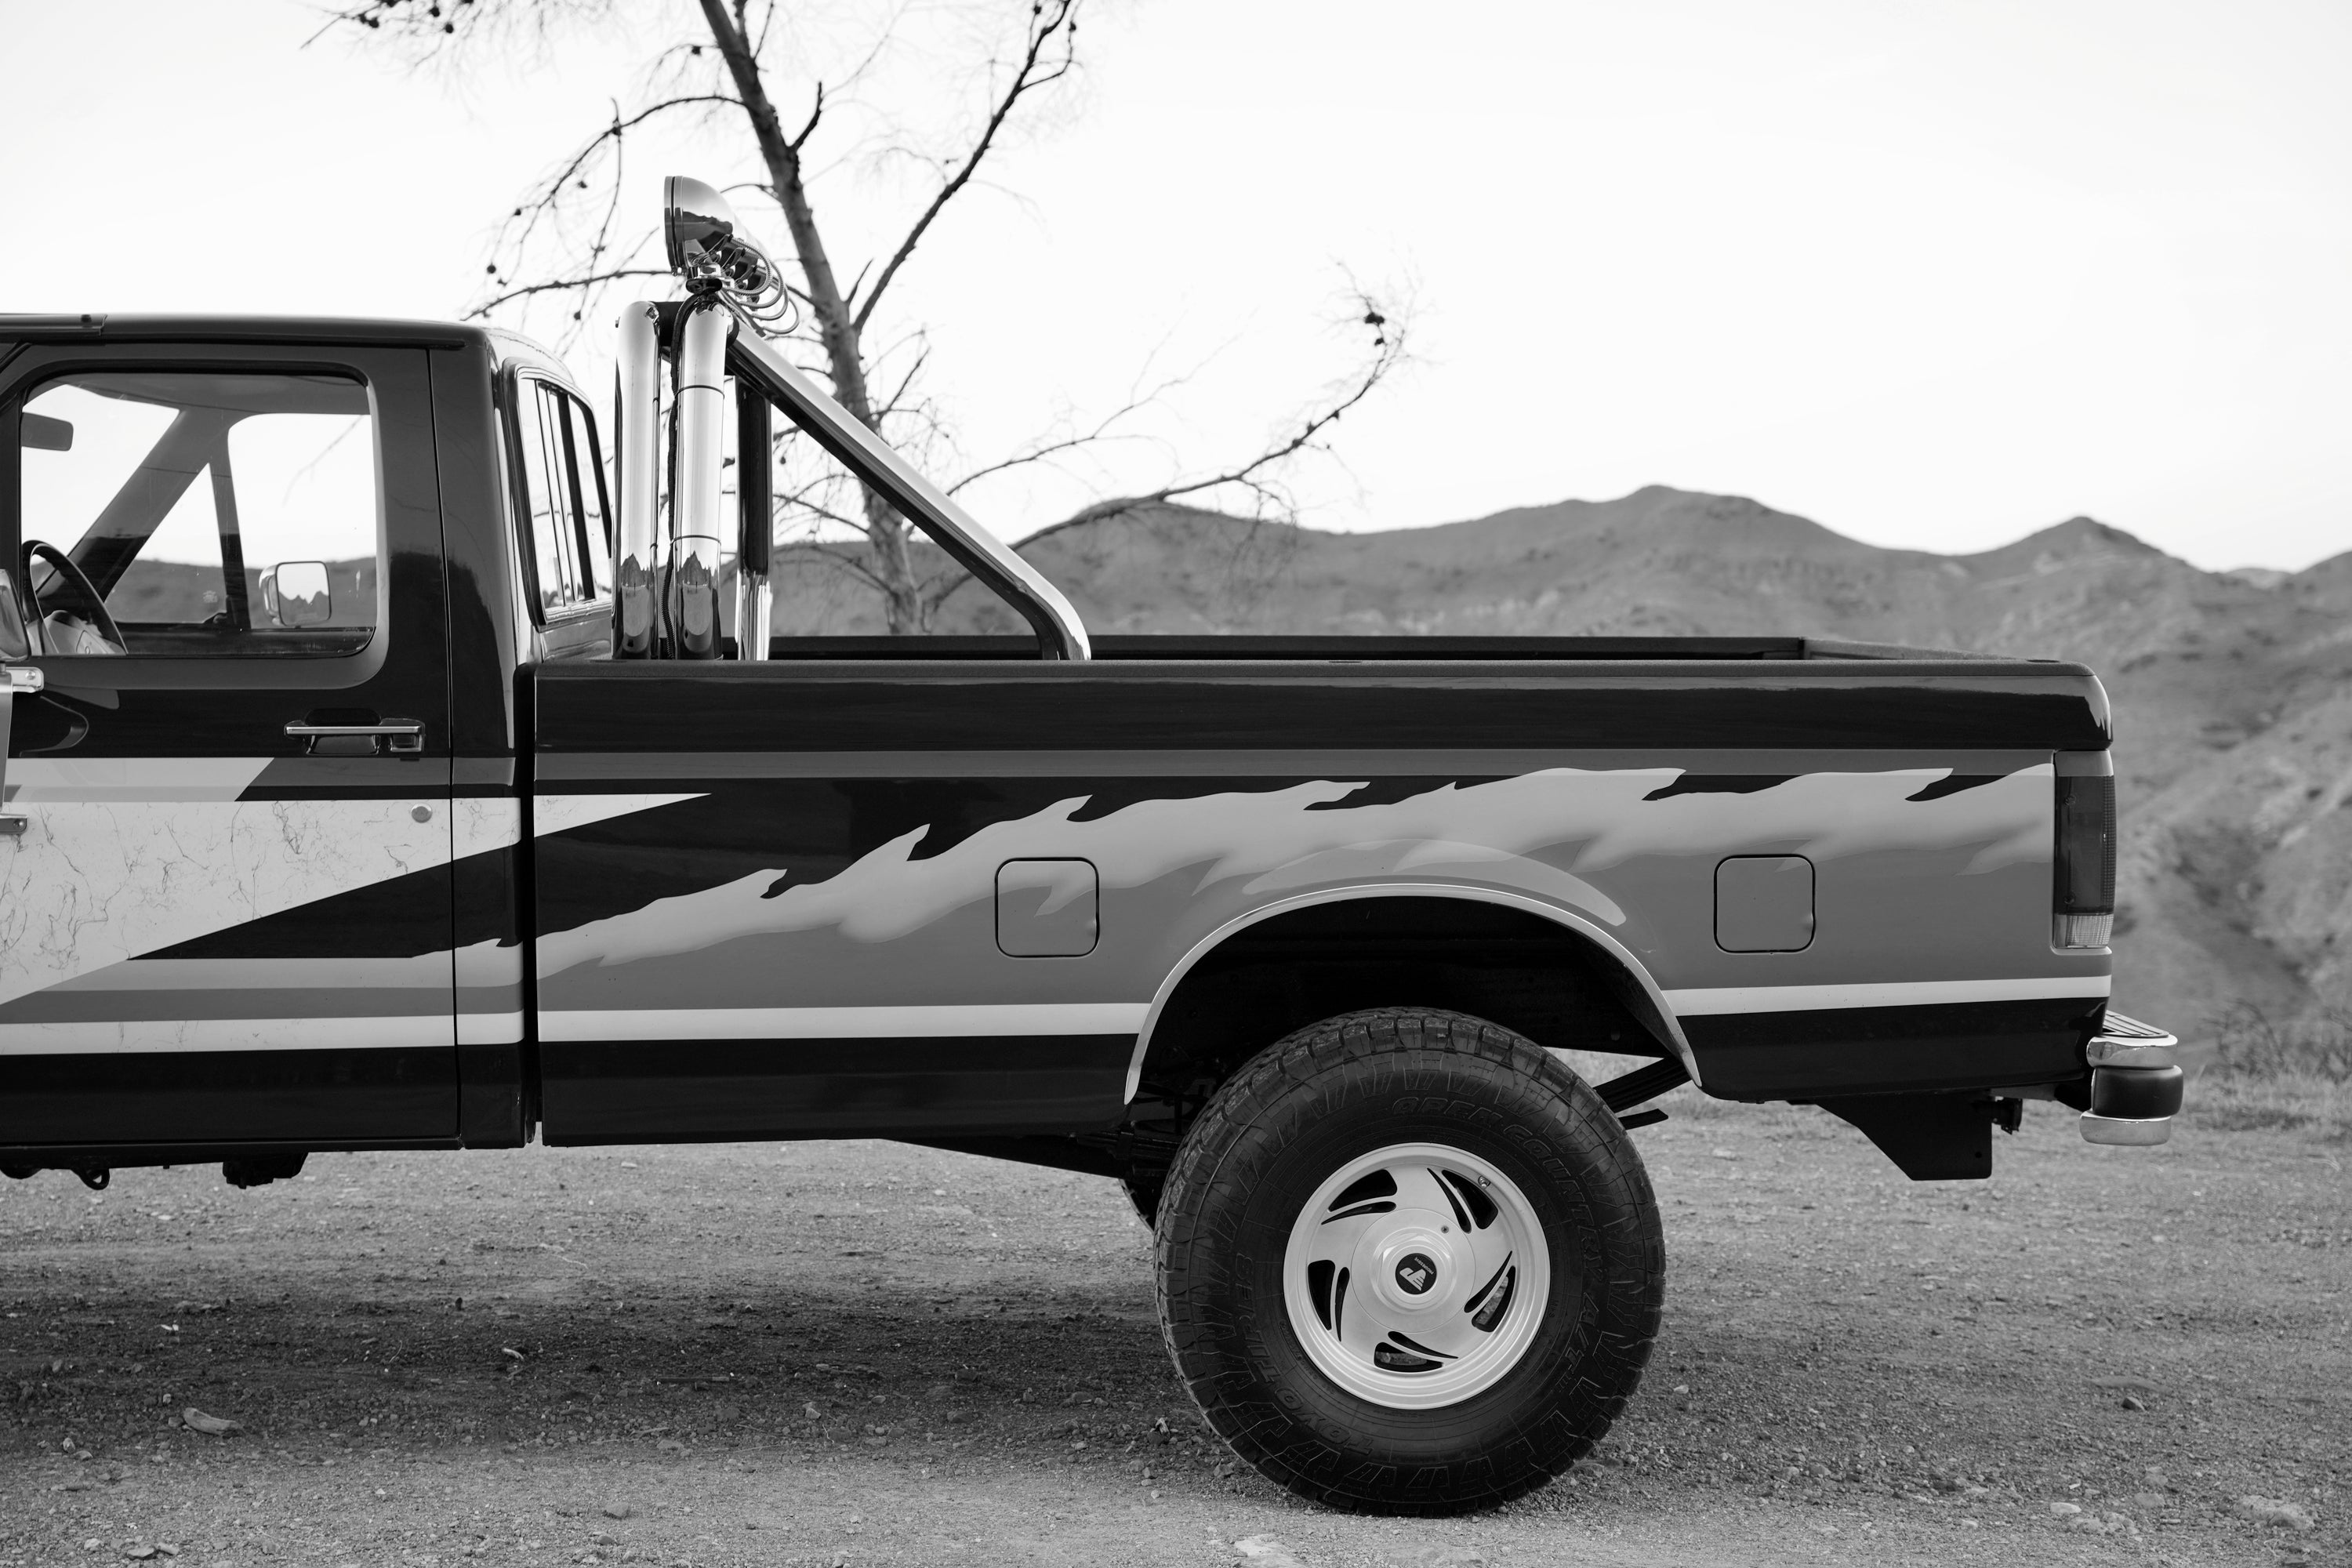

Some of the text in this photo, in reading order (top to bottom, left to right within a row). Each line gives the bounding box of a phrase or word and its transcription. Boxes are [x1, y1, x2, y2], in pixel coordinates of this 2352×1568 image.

[1392, 1096, 1503, 1127] OPEN
[1503, 1124, 1604, 1281] COUNTRY
[1235, 1252, 1281, 1384] TIRES
[1274, 1387, 1374, 1456] TOYO
